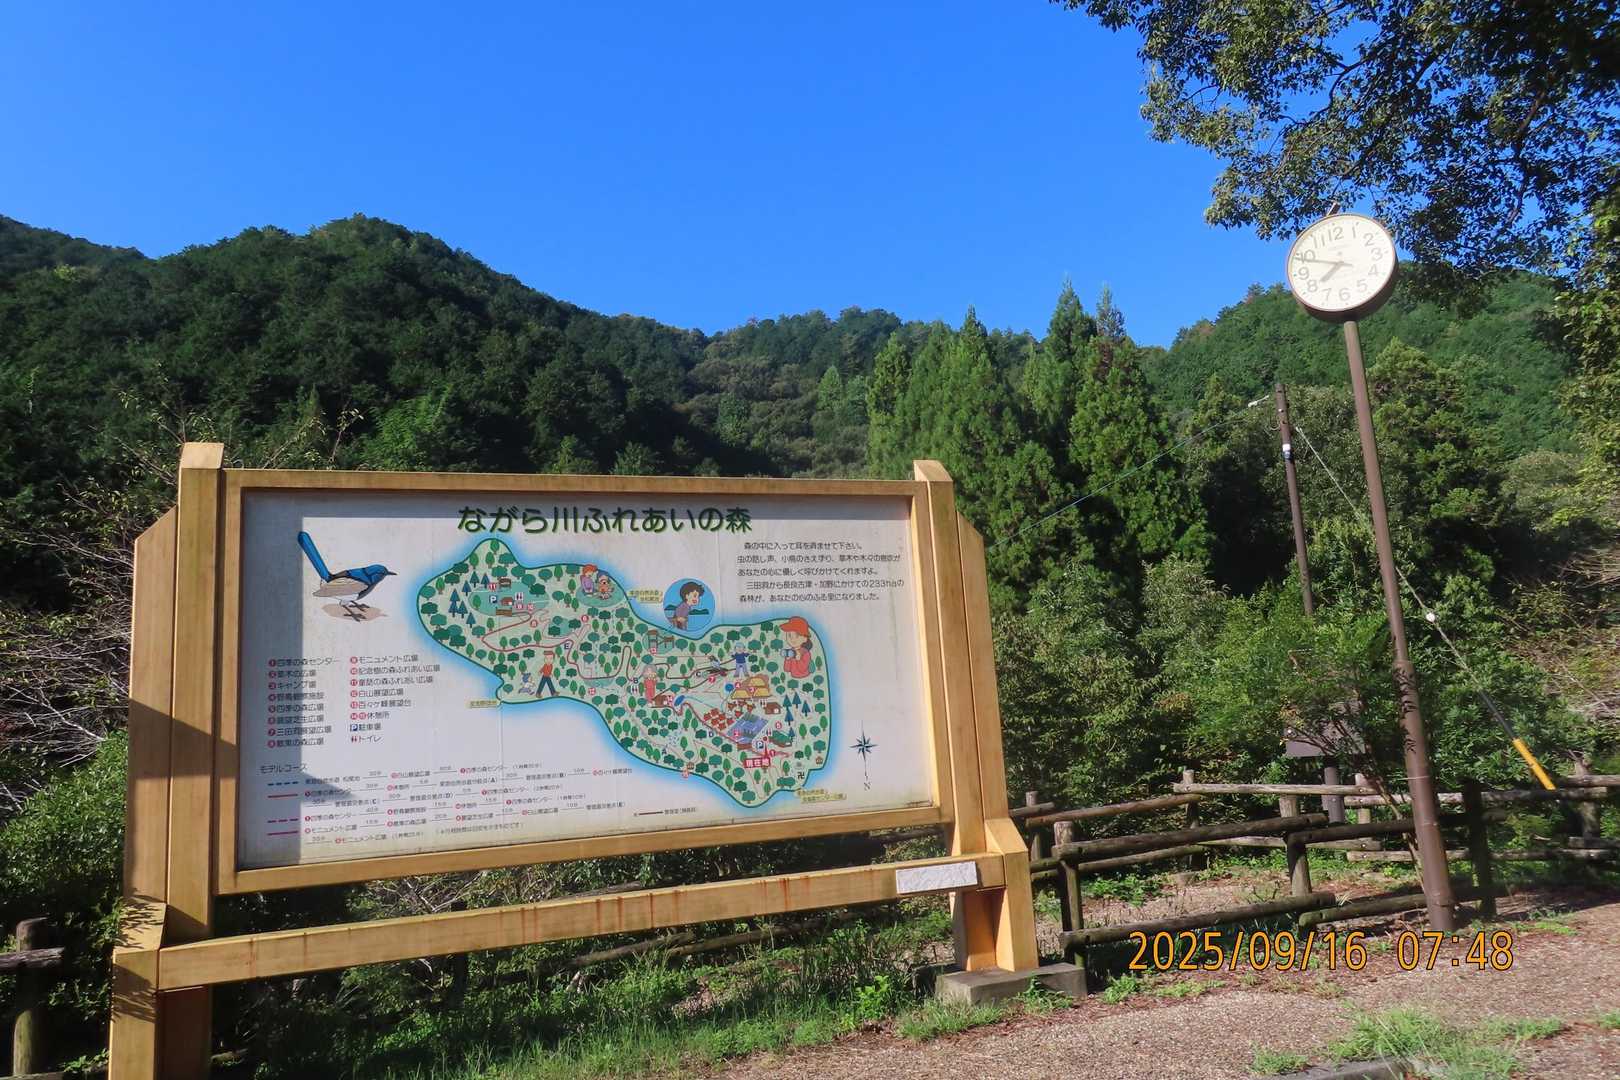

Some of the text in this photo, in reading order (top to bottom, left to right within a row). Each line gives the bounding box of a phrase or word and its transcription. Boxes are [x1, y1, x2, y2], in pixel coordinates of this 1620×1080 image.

[1328, 226, 1343, 241] 12
[1352, 226, 1356, 239] 1
[1363, 232, 1374, 247] 2
[1313, 233, 1325, 248] 11
[1299, 249, 1316, 263] 10
[1371, 247, 1383, 261] 3
[1298, 266, 1309, 280] 9
[1368, 264, 1379, 276] 4
[1307, 279, 1318, 293] 8
[1356, 279, 1368, 293] 5
[1320, 287, 1332, 301] 7
[1339, 287, 1351, 301] 6
[457, 506, 752, 533] ながら川ふれあいの森
[277, 657, 340, 667] 四季の森センター
[359, 654, 418, 664] モニュメント広場
[278, 681, 316, 689] キャンプ場
[359, 735, 382, 743] トイレ
[745, 758, 770, 768] 現在地
